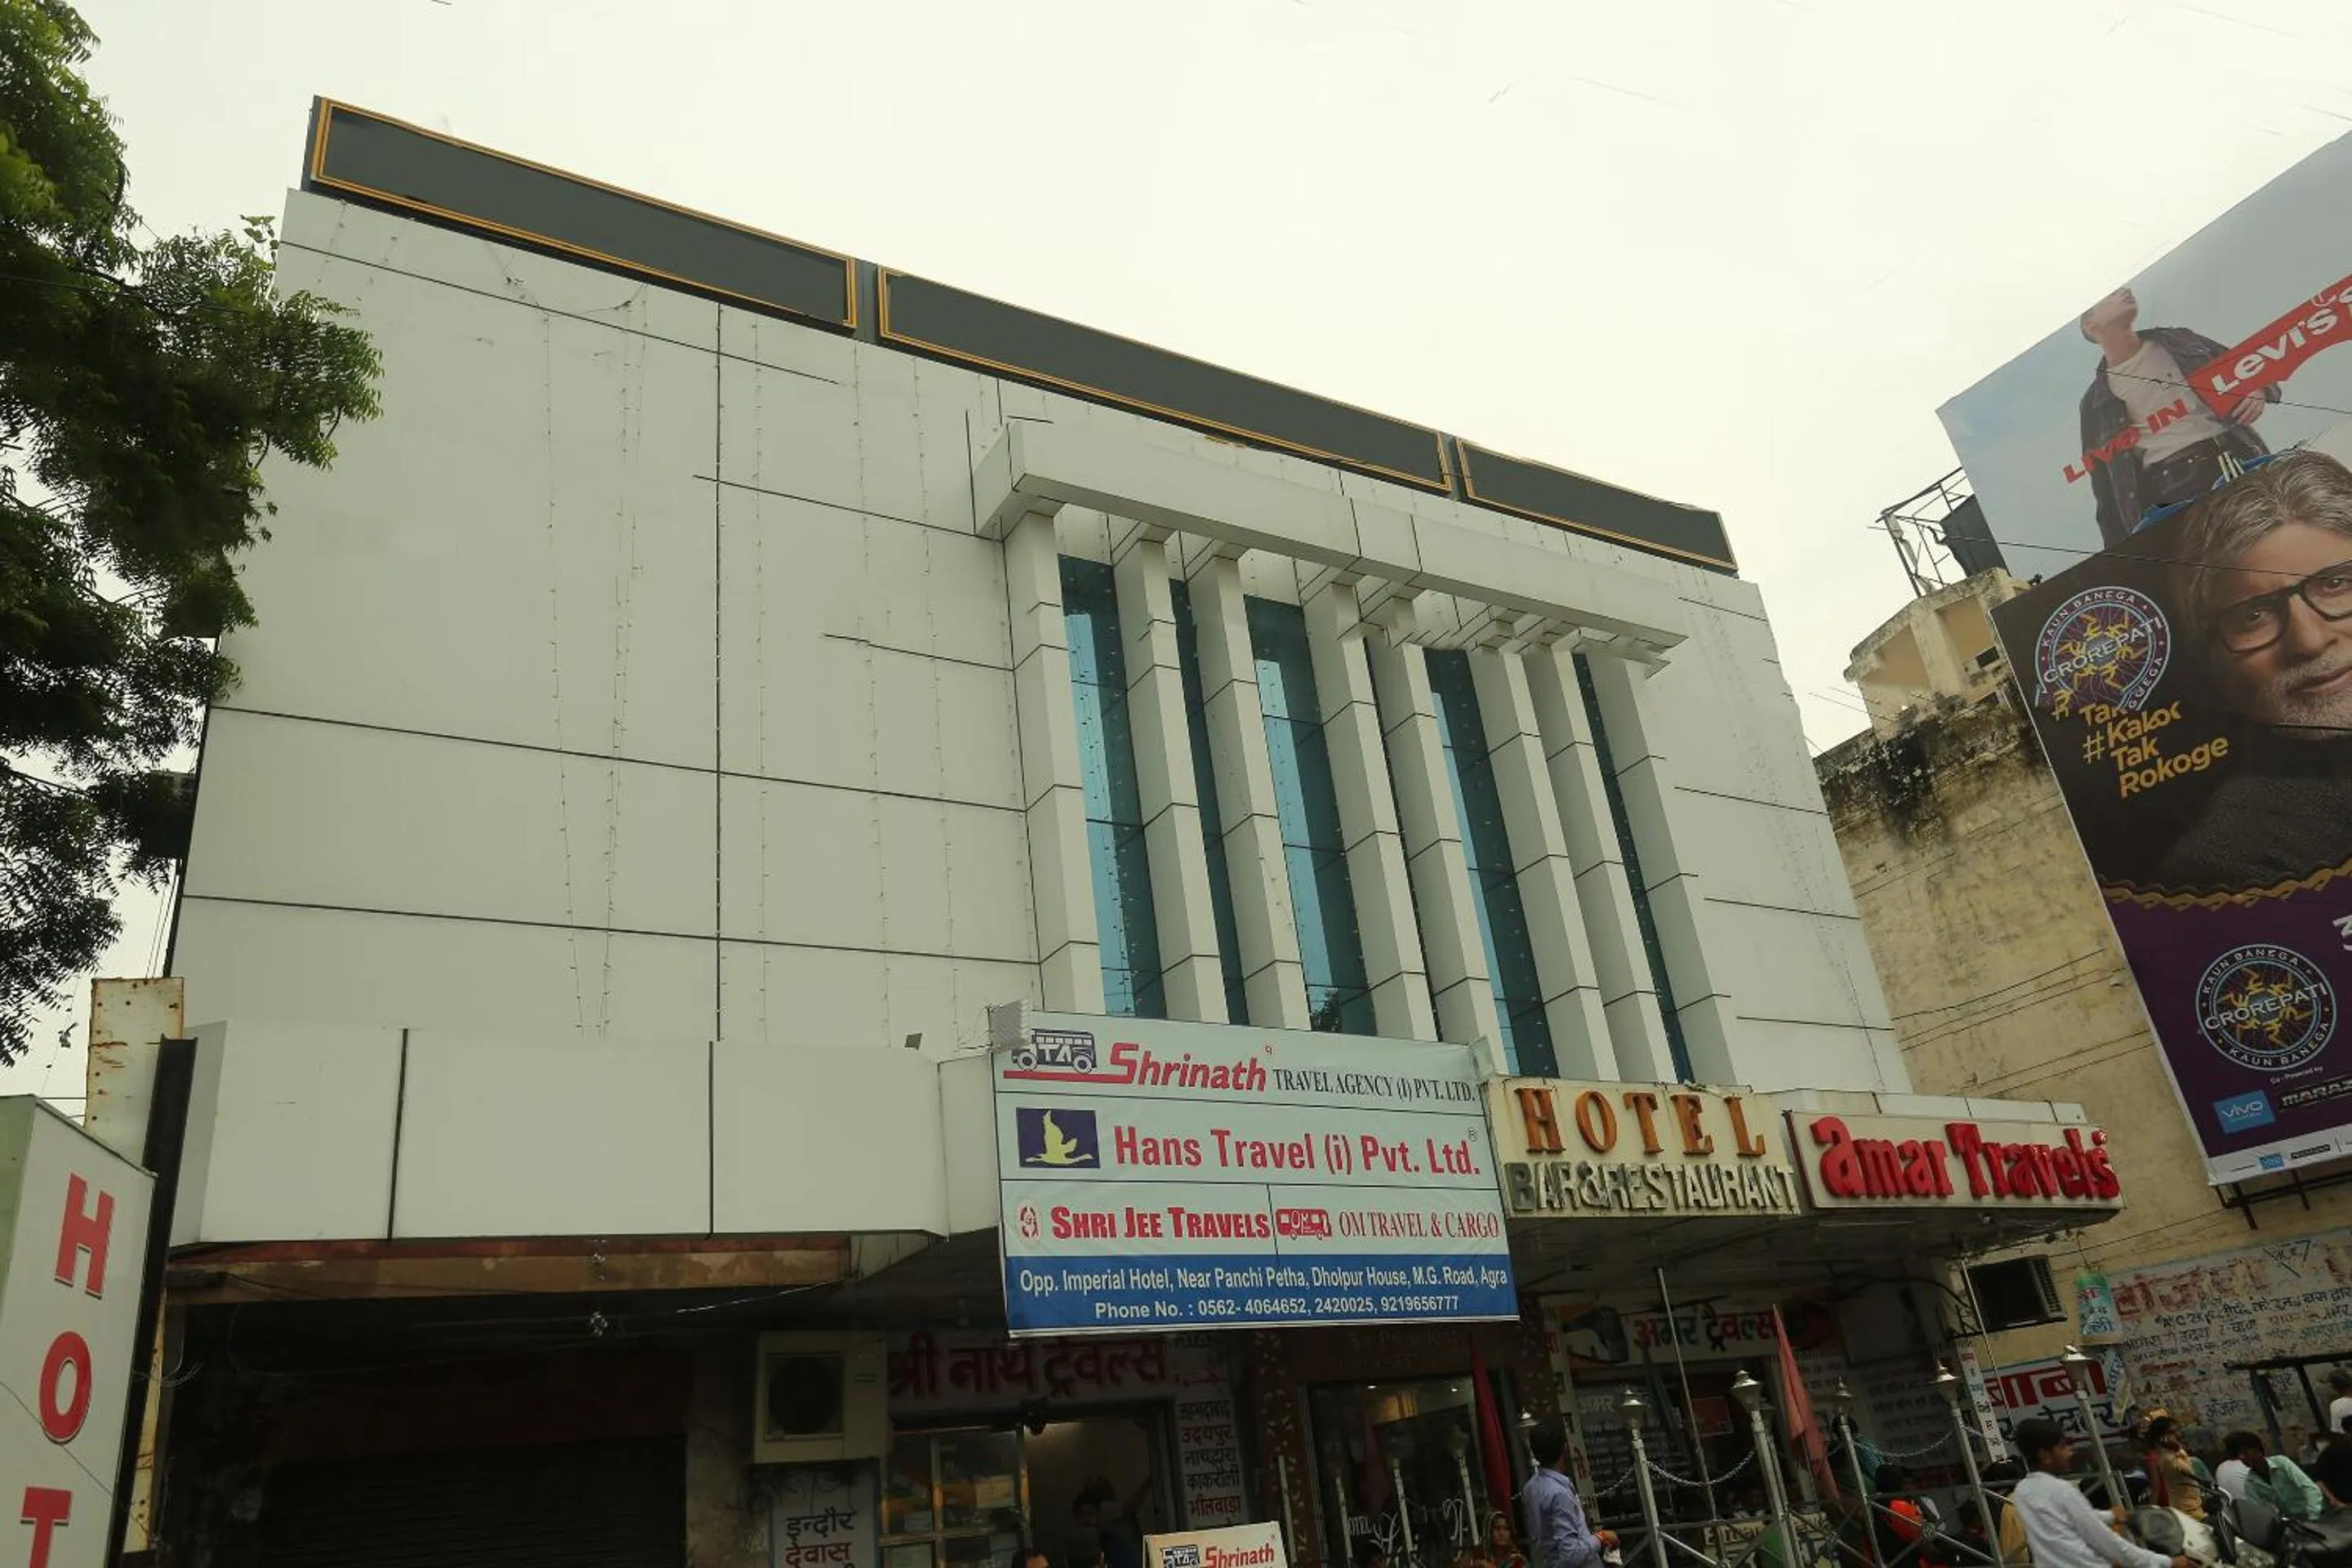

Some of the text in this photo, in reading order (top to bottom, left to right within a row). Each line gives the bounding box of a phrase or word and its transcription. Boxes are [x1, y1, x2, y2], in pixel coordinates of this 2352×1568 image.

[2147, 399, 2189, 434] IN
[2042, 590, 2136, 648] KAUN BANEGA
[2044, 617, 2163, 683] CROREPATI
[2110, 736, 2160, 772] Tak
[2119, 737, 2230, 798] Rokoge
[2202, 947, 2301, 994] KAUN BANEGA
[2204, 982, 2328, 1030] CROREPATI
[2229, 1022, 2331, 1067] KAUN BANEGA
[1109, 1041, 1267, 1092] Shrinath
[1272, 1068, 1334, 1093] TRAVEL
[1336, 1073, 1394, 1098] AGENCY
[1414, 1079, 1444, 1100] PVT.
[1445, 1080, 1477, 1102] LTD.
[1514, 1087, 1767, 1156] HOTEL
[1114, 1125, 1481, 1176] Hans Travel (i) Pvt. Ltd.
[1050, 1206, 1271, 1240] SHRI JEE TRAVELS
[1339, 1211, 1369, 1238] OM
[1367, 1211, 1428, 1238] TRAVEL
[1431, 1211, 1443, 1238] &
[1445, 1210, 1499, 1239] CARGO
[1020, 1266, 1508, 1297] Opp. Imperial Hotel, Near Panchi Petha, Dholpur House, M.G. Road, Agra
[1095, 1301, 1150, 1318] Phone
[1155, 1300, 1183, 1317] No.
[1381, 1295, 1459, 1312] 9219656777
[1205, 1543, 1275, 1568] Shrinath
